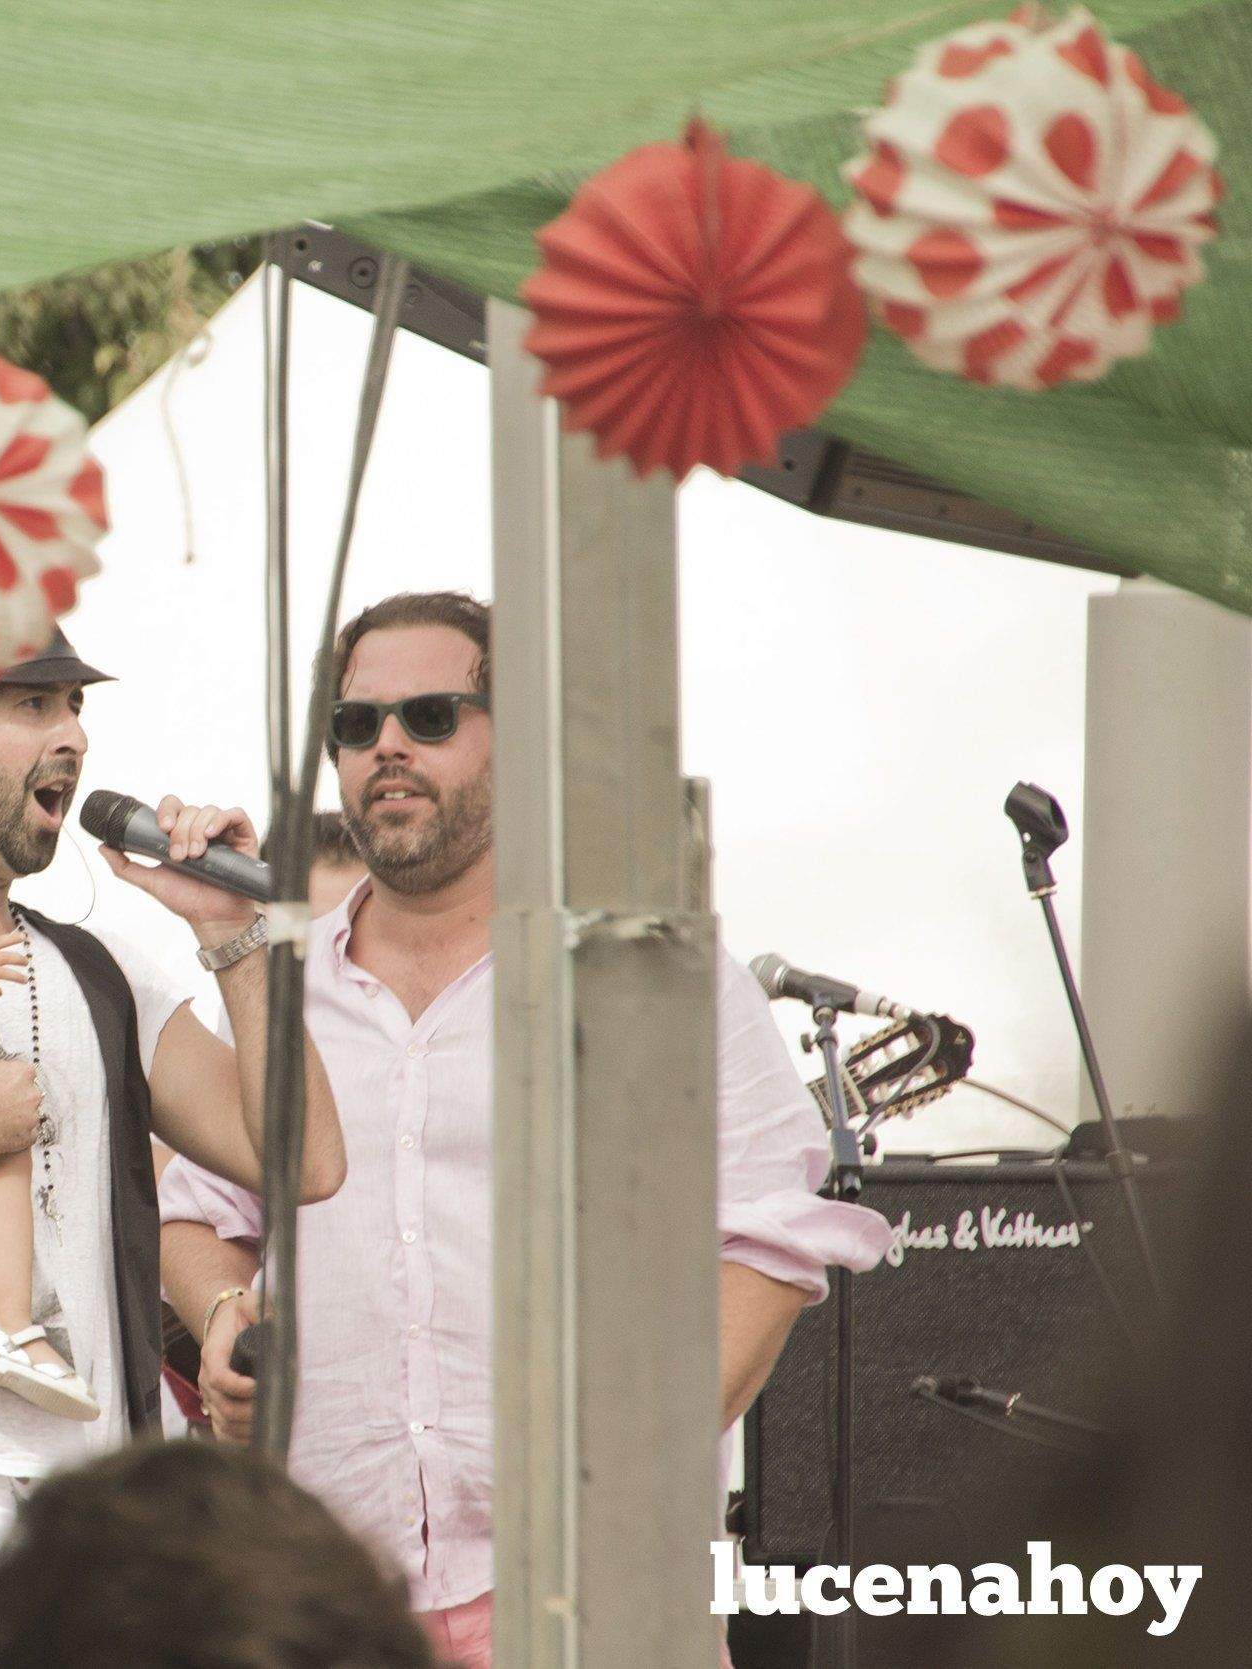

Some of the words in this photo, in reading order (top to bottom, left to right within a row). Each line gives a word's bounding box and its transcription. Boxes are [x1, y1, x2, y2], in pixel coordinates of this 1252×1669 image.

[886, 1211, 949, 1267] ghes
[953, 1210, 979, 1251] &
[981, 1206, 1093, 1249] Kettner
